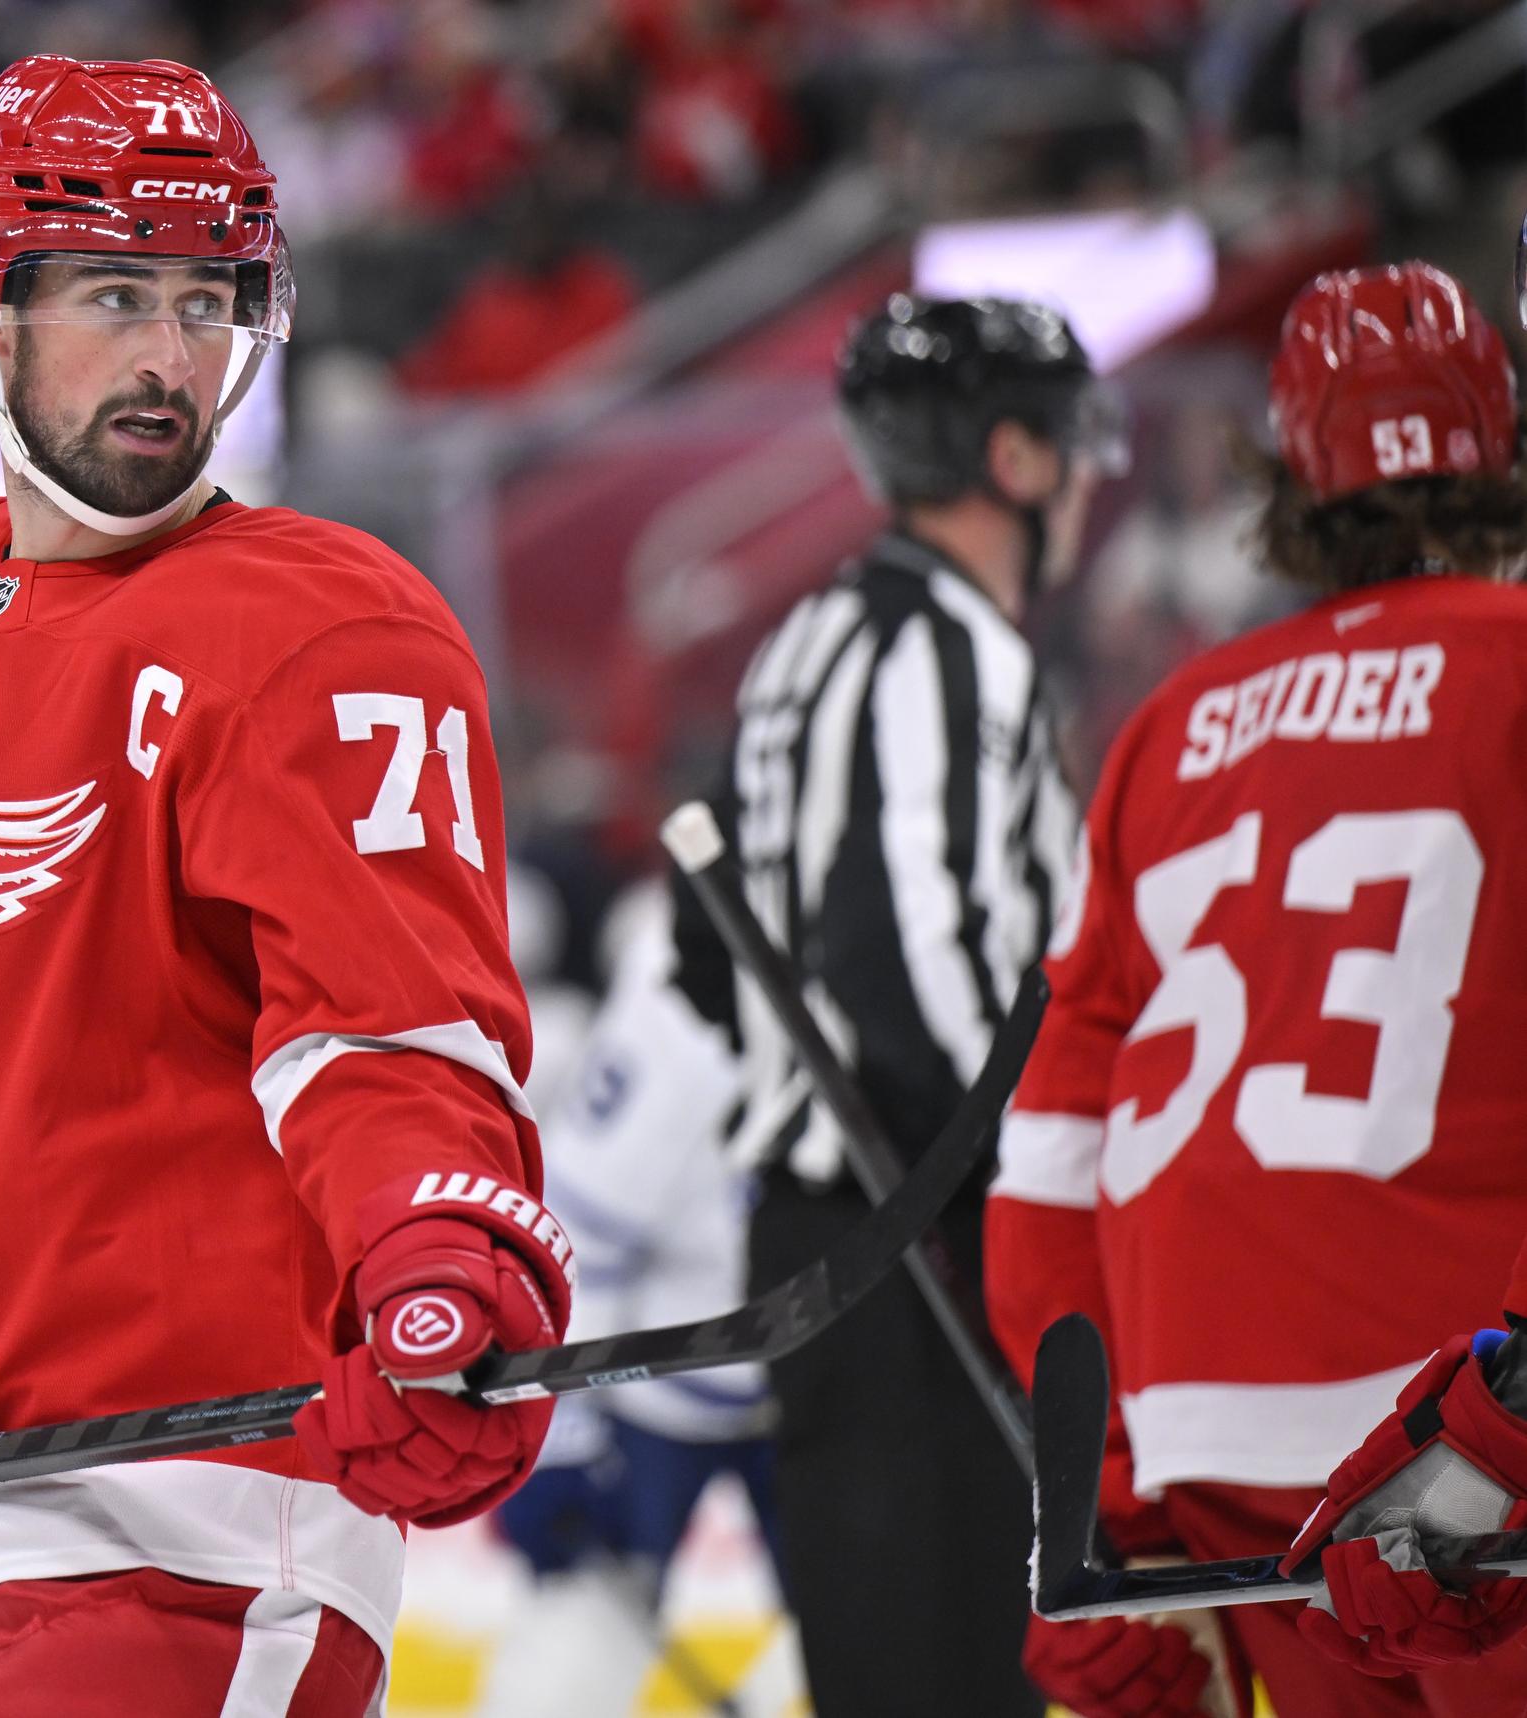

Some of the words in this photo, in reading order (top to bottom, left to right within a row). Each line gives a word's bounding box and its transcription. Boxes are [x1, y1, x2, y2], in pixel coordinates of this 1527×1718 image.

[135, 99, 202, 137] 71
[130, 178, 234, 203] CCM
[1371, 414, 1434, 477] 53
[126, 664, 184, 780] C
[331, 692, 485, 873] 71
[1099, 807, 1486, 1208] 53
